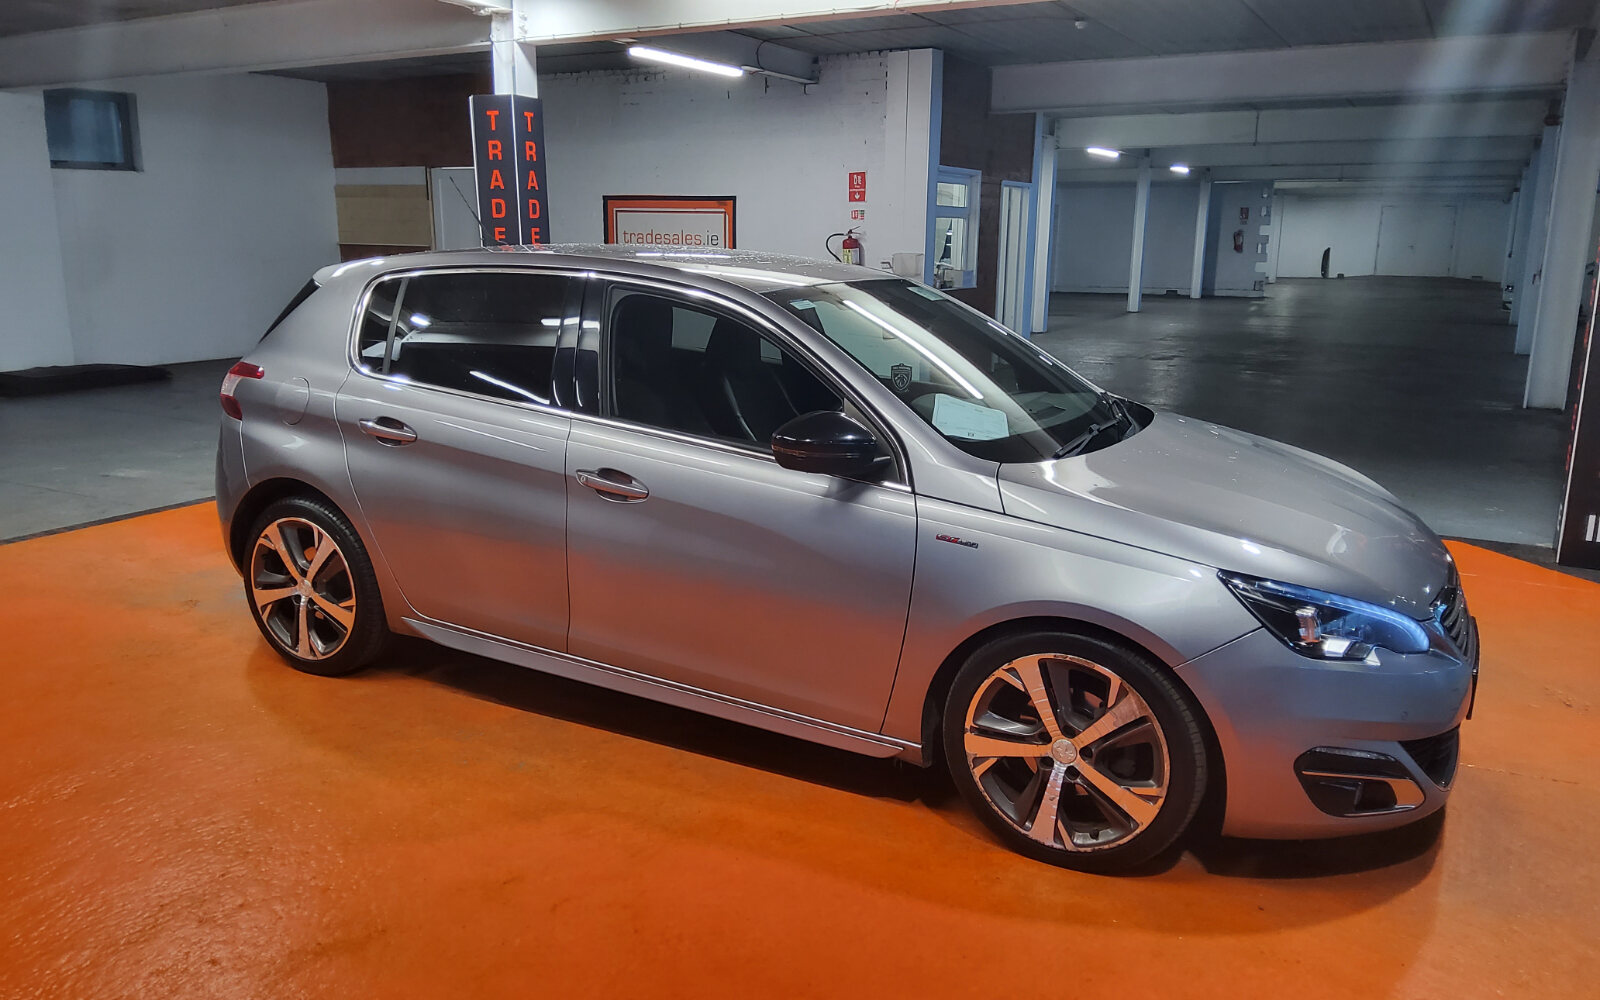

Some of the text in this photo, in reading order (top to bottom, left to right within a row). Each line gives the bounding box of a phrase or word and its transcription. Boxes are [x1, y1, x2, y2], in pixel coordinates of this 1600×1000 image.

[486, 110, 506, 242] TRADE
[524, 112, 540, 246] TRADE
[623, 229, 719, 246] tradesales.ie
